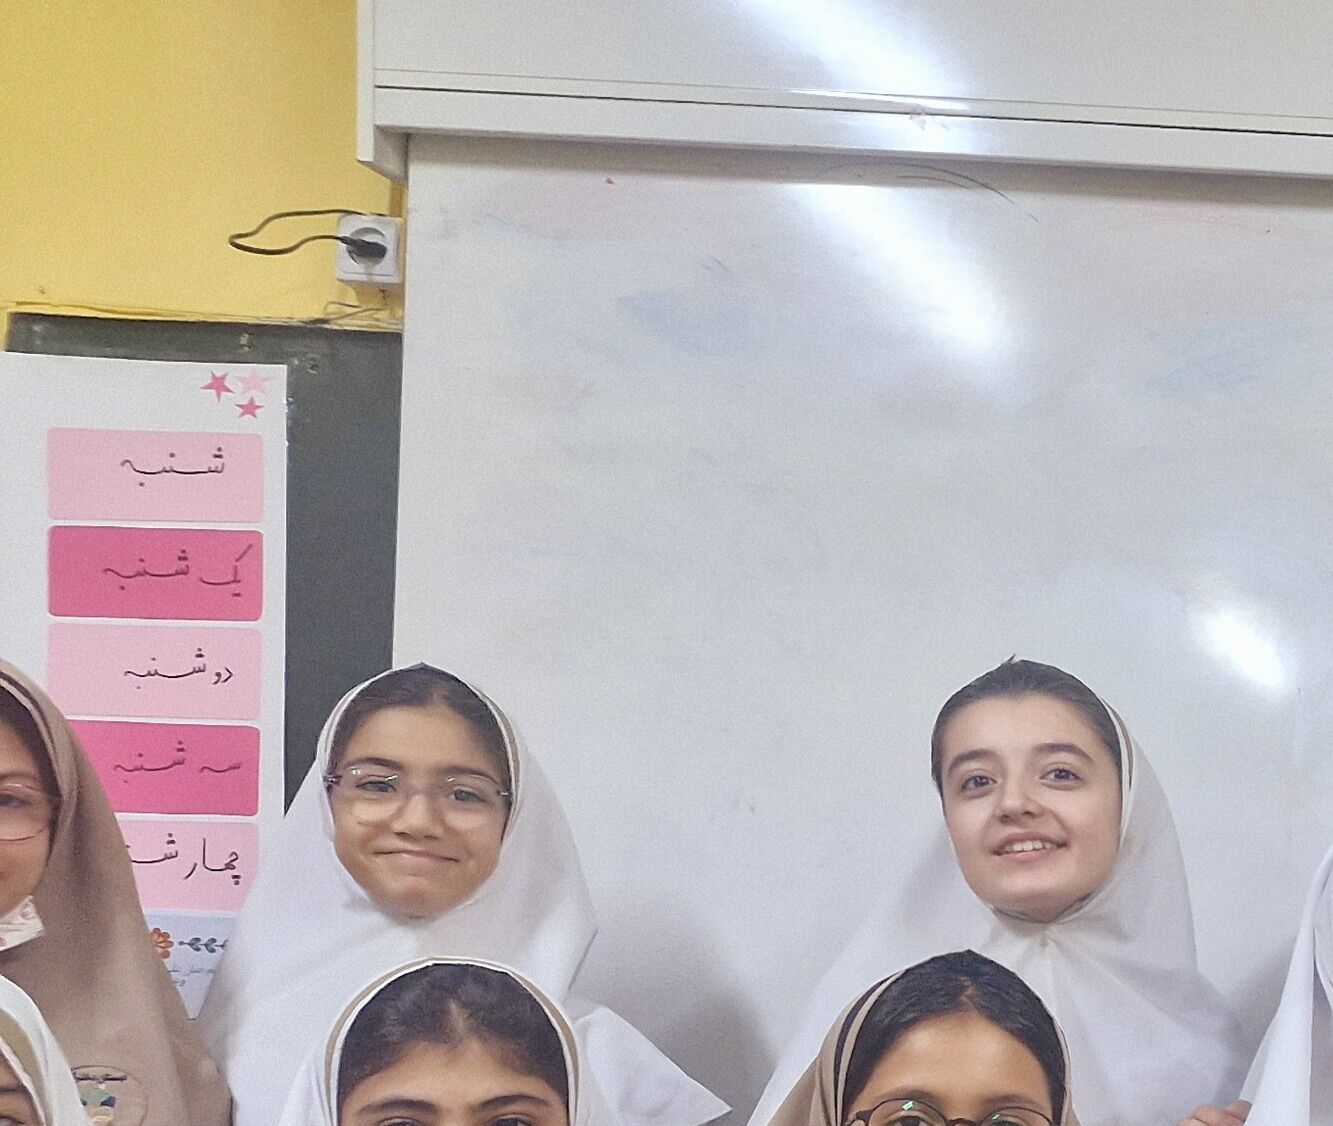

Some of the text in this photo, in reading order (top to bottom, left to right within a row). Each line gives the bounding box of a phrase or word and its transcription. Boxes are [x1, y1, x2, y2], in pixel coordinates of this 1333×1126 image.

[120, 446, 225, 487] شنبه
[104, 543, 253, 598] یک شنبه
[114, 740, 242, 783] سه شنبه
